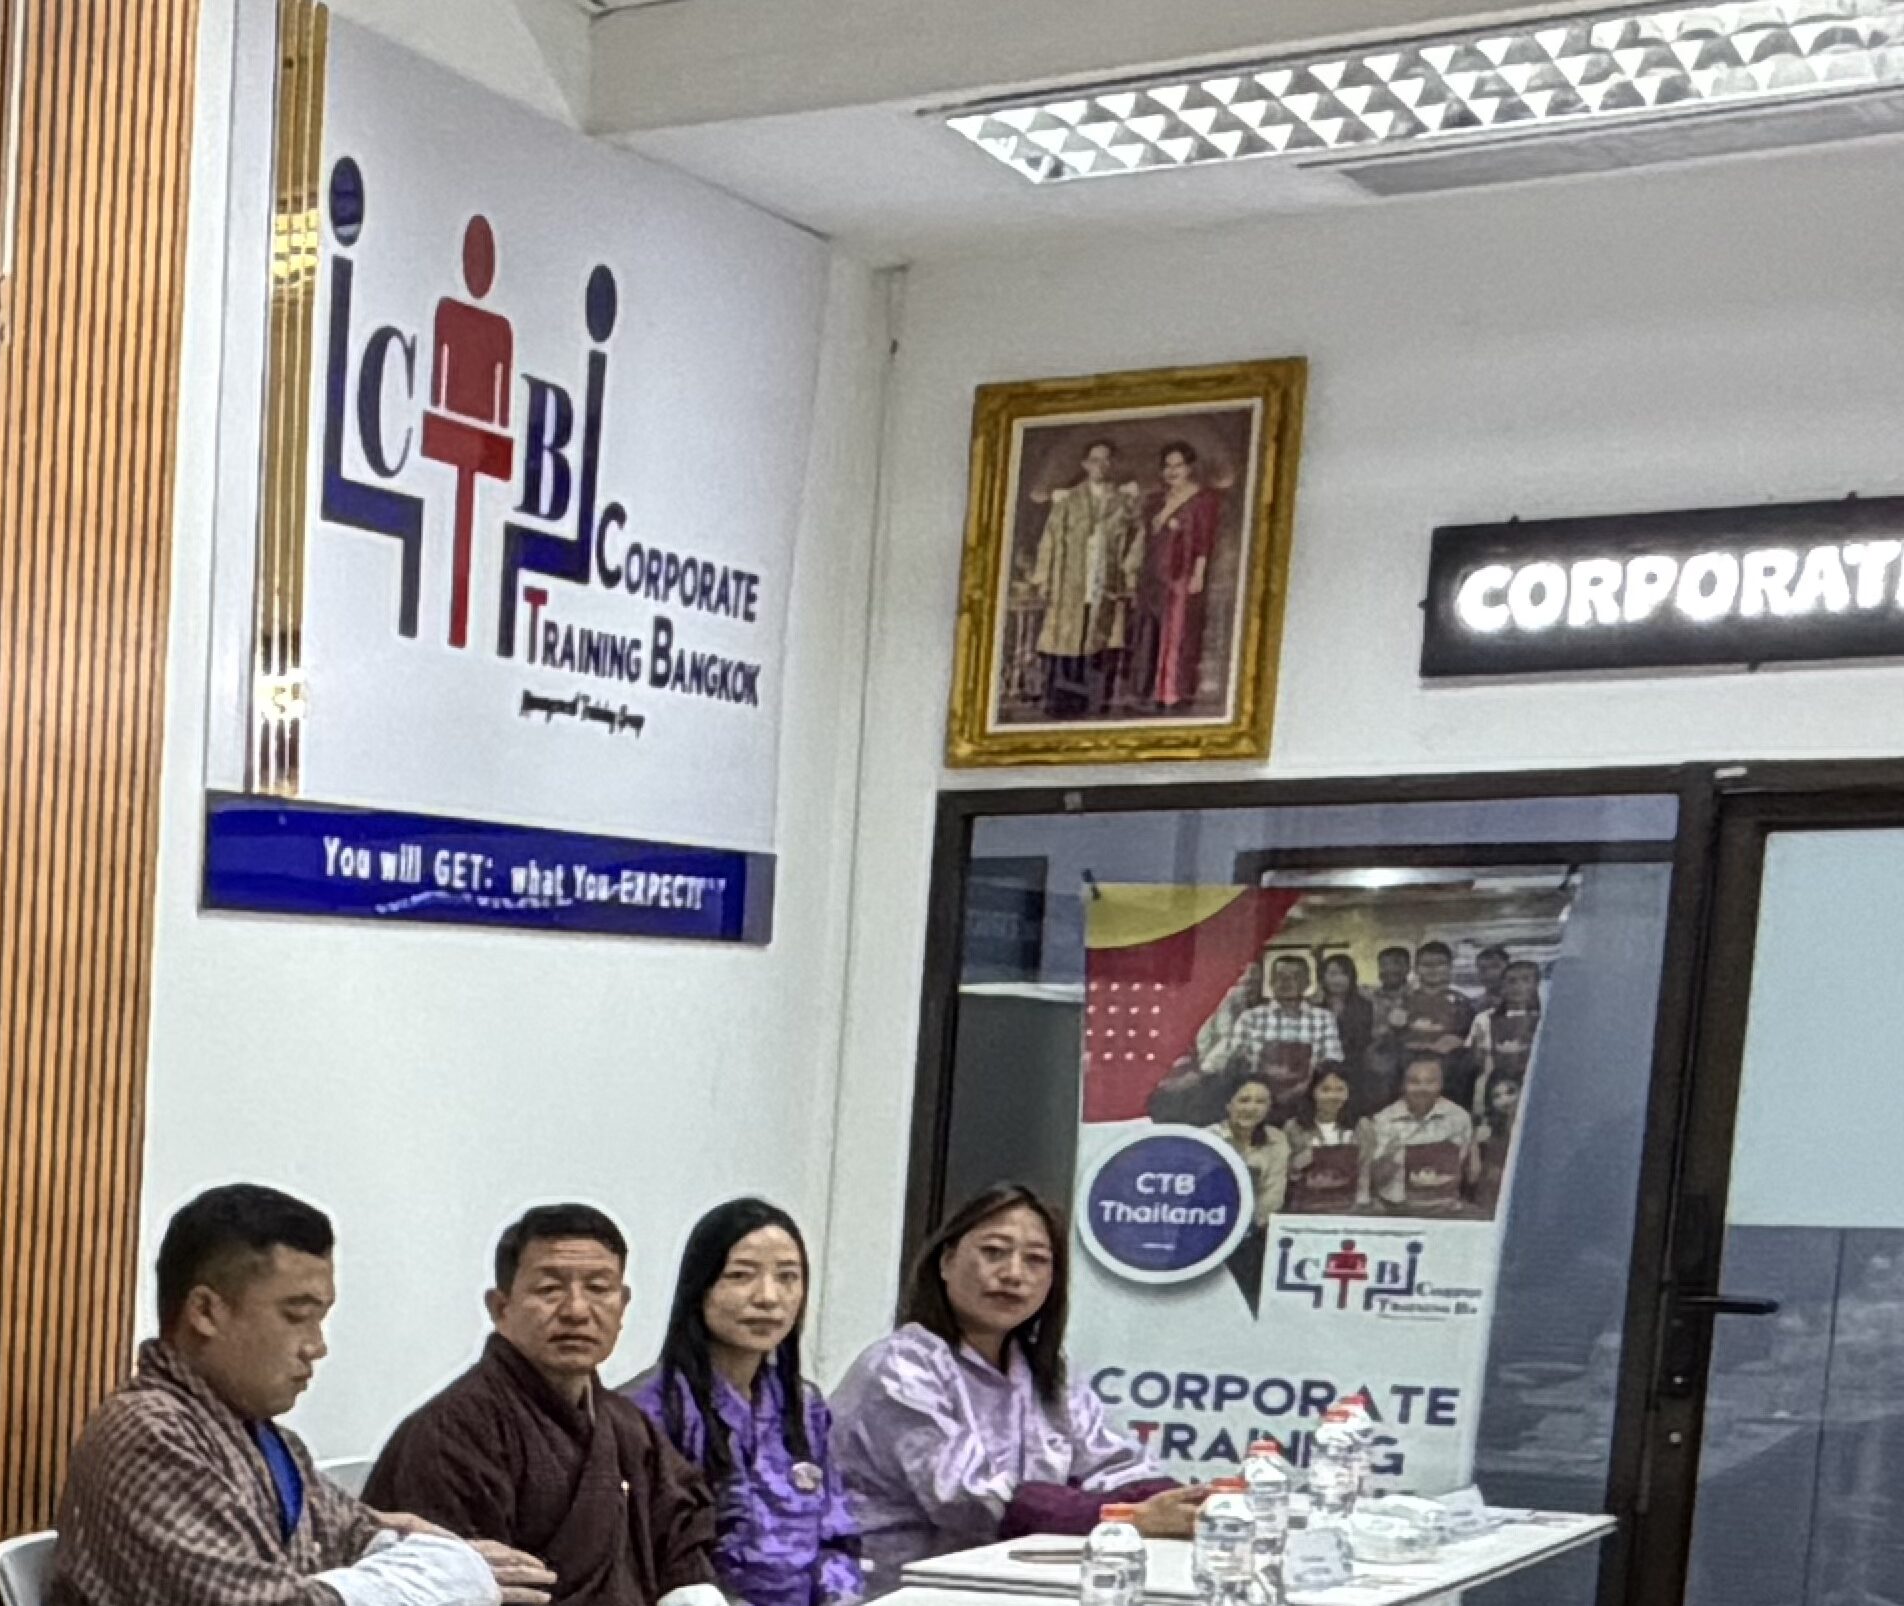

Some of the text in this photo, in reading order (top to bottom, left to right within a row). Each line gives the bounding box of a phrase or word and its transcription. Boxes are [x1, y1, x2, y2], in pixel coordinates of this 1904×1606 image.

[596, 501, 760, 623] CORPORATE
[1455, 539, 1904, 632] CORPORAT
[524, 588, 760, 707] TRAINING BANGKOK
[323, 836, 371, 881] You
[1098, 1199, 1227, 1226] Thailand
[1135, 1172, 1195, 1195] CTB
[1091, 1366, 1460, 1427] CORPORATE
[1127, 1420, 1405, 1476] TRANIG
